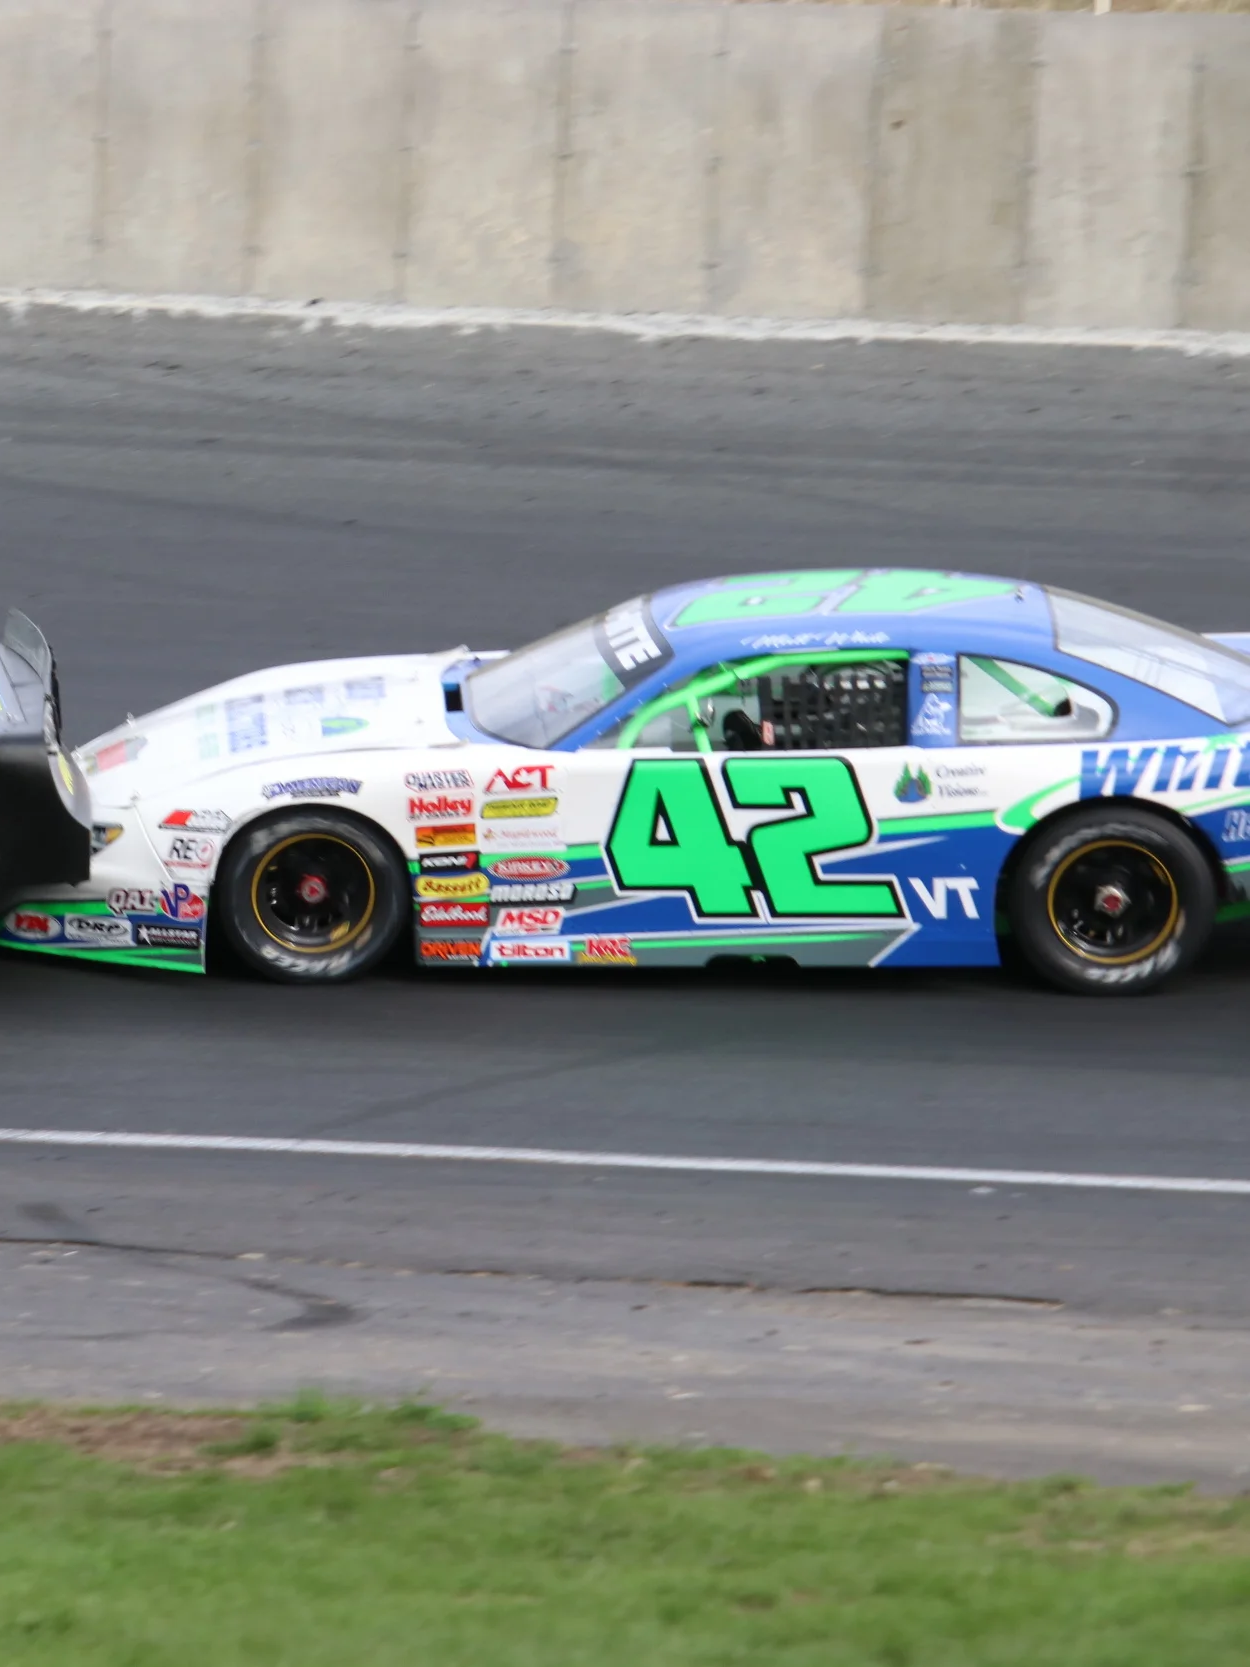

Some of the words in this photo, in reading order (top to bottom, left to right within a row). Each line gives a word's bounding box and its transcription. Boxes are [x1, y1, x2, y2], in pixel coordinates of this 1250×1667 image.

[485, 765, 555, 793] ACT
[408, 796, 473, 817] Holley
[607, 757, 904, 917] 42
[421, 855, 468, 868] KONI
[908, 876, 980, 919] VT
[501, 908, 562, 927] MSD
[421, 942, 482, 960] DRIVEN
[497, 943, 567, 959] tilton
